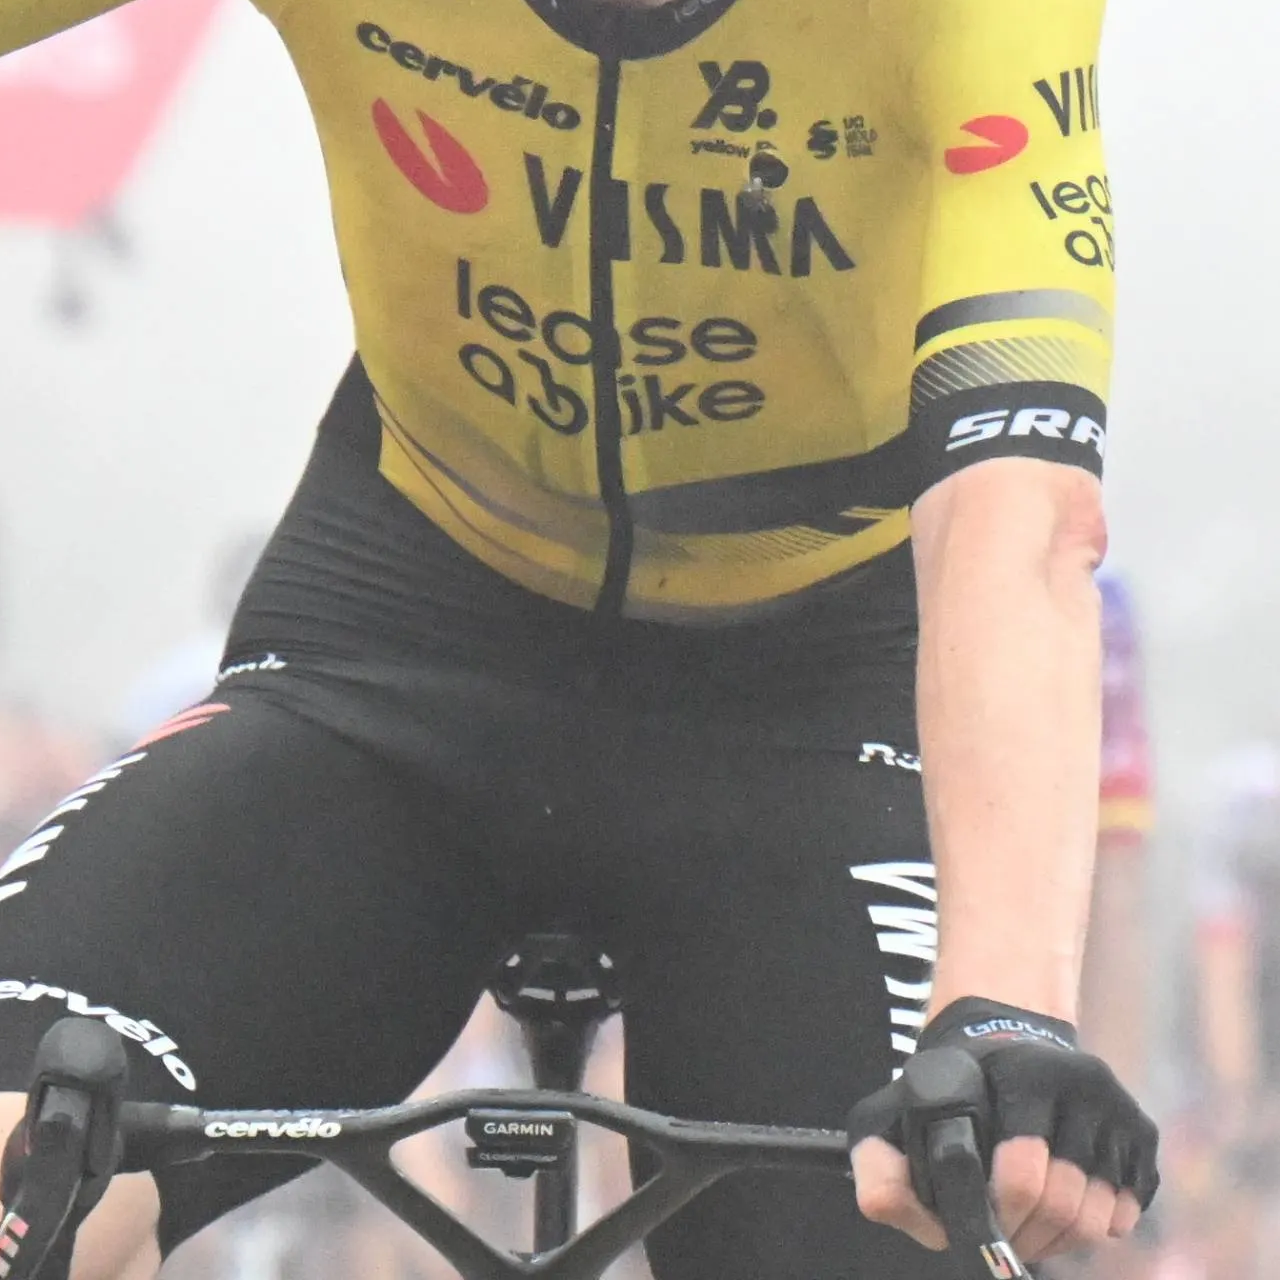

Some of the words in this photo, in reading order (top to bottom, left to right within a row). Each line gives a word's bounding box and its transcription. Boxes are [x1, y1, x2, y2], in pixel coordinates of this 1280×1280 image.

[356, 21, 581, 130] cervélo
[523, 151, 856, 279] VISMA
[456, 258, 758, 368] lease
[204, 1117, 342, 1138] cervélo
[483, 1122, 554, 1136] GARMIN
